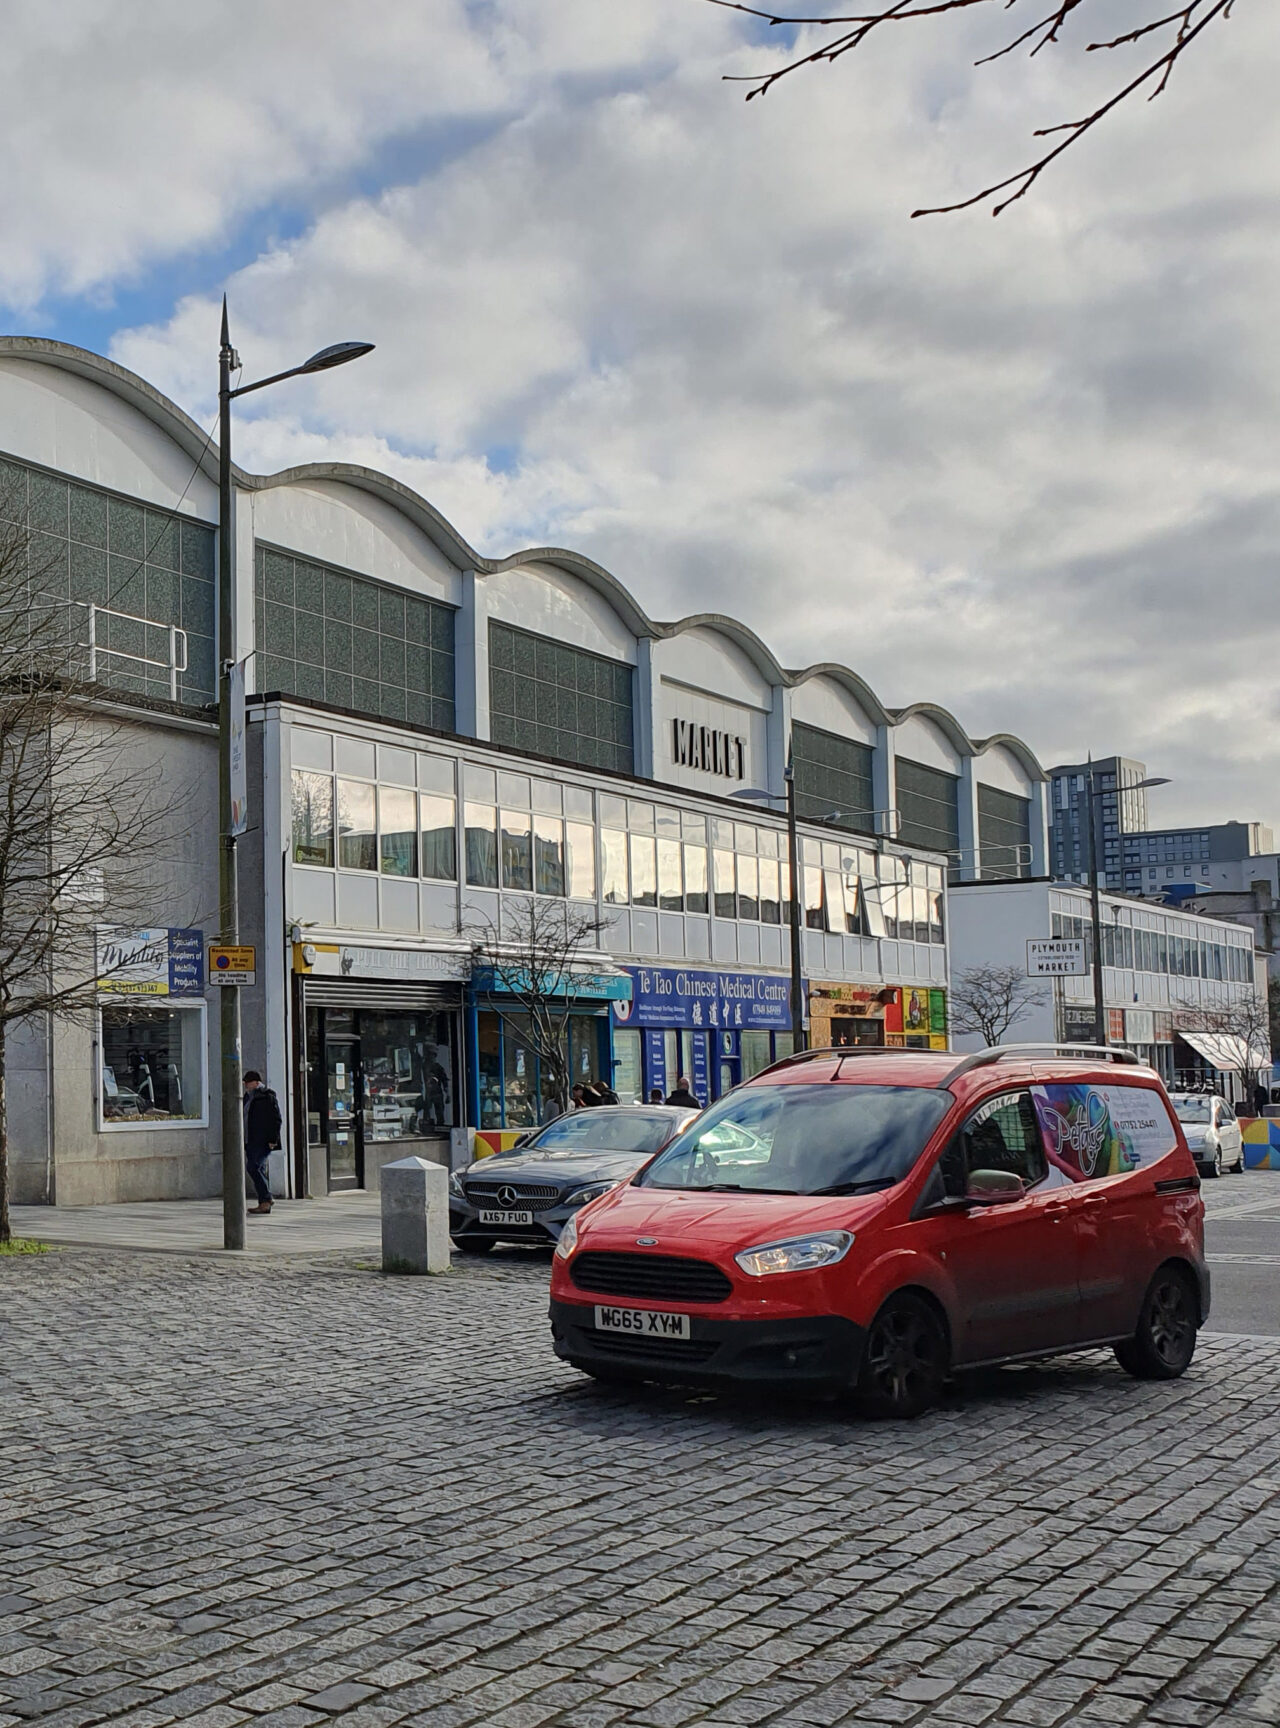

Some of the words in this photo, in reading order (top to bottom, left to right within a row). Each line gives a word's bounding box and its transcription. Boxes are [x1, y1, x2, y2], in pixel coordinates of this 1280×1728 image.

[670, 718, 747, 781] MARKET
[1032, 943, 1080, 953] PLYMOUTH
[196, 951, 202, 960] of
[174, 964, 197, 975] Mobility
[1038, 962, 1075, 972] MARKET
[638, 970, 650, 993] Te
[653, 972, 671, 995] Tao
[675, 973, 717, 997] Chinese
[719, 976, 755, 999] Medical
[757, 979, 786, 1001] Centre
[483, 1212, 505, 1222] AX67
[508, 1212, 528, 1223] FUO
[601, 1308, 643, 1330] WG65
[648, 1313, 683, 1335] XYM
